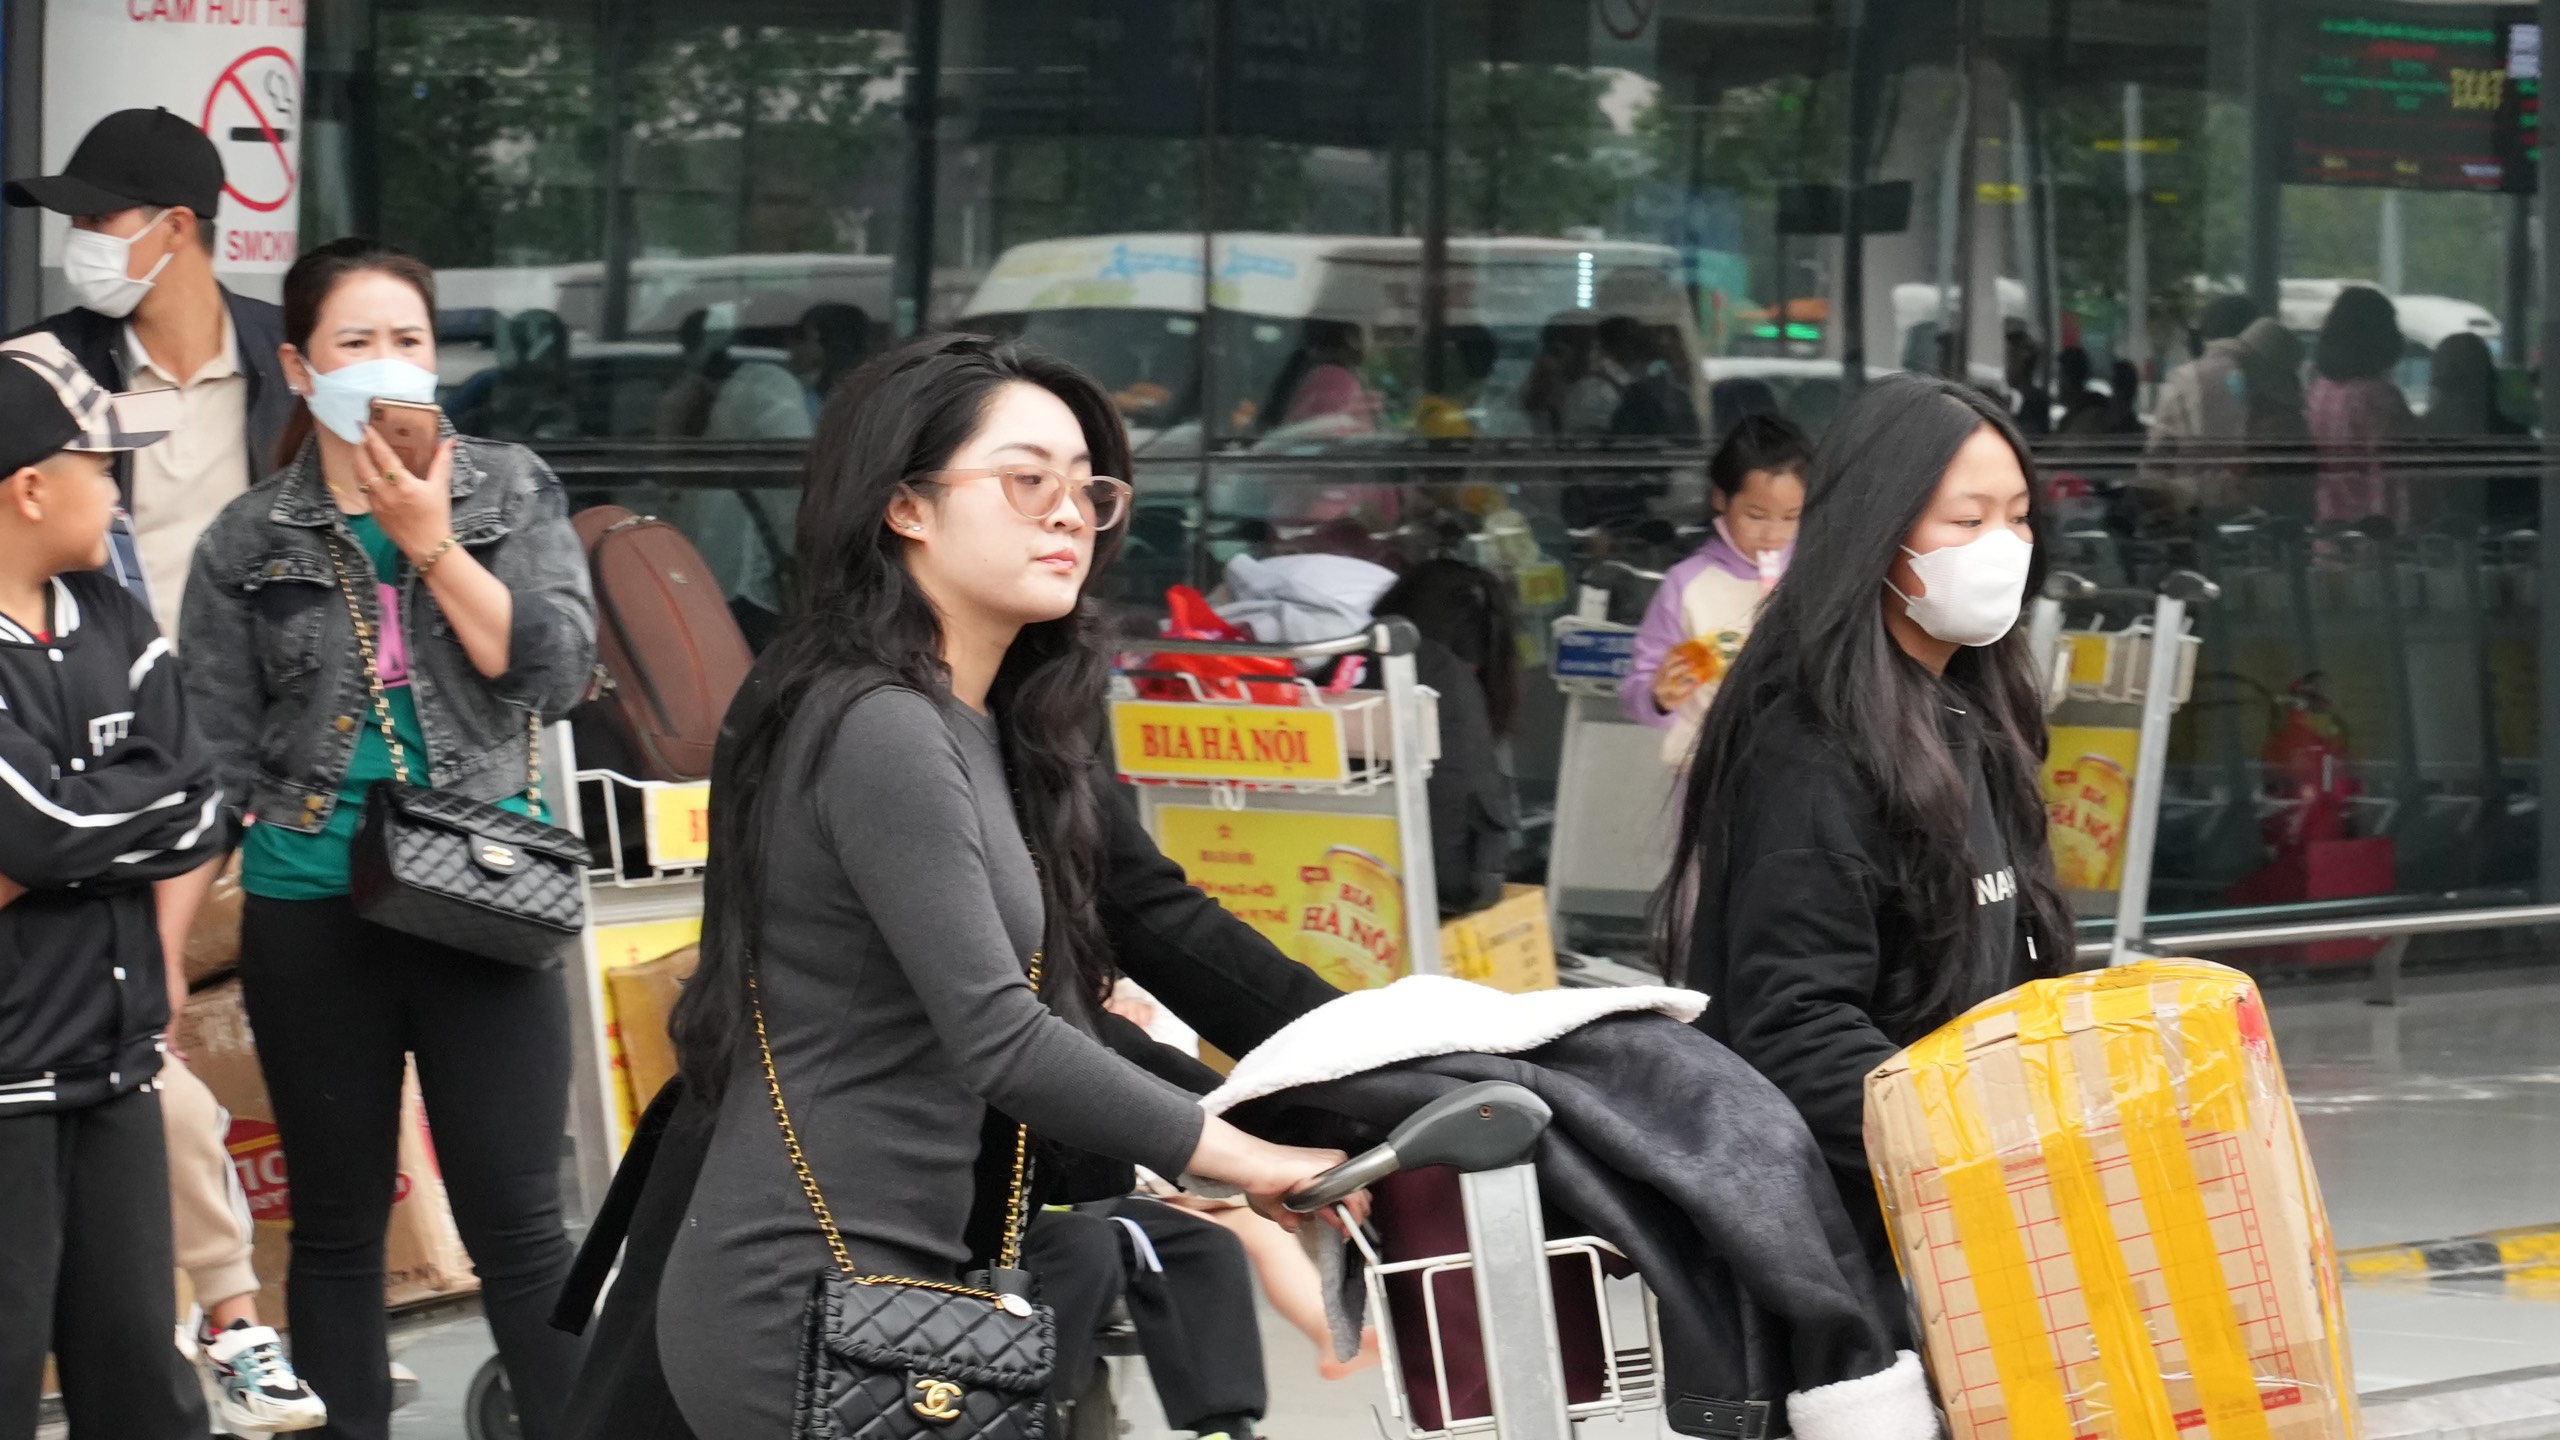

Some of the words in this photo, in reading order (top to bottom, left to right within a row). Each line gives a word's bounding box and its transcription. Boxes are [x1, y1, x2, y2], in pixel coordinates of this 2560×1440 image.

[1141, 723, 1196, 759] BIA
[1199, 714, 1247, 762] HÀ
[1250, 719, 1312, 774] NỘI
